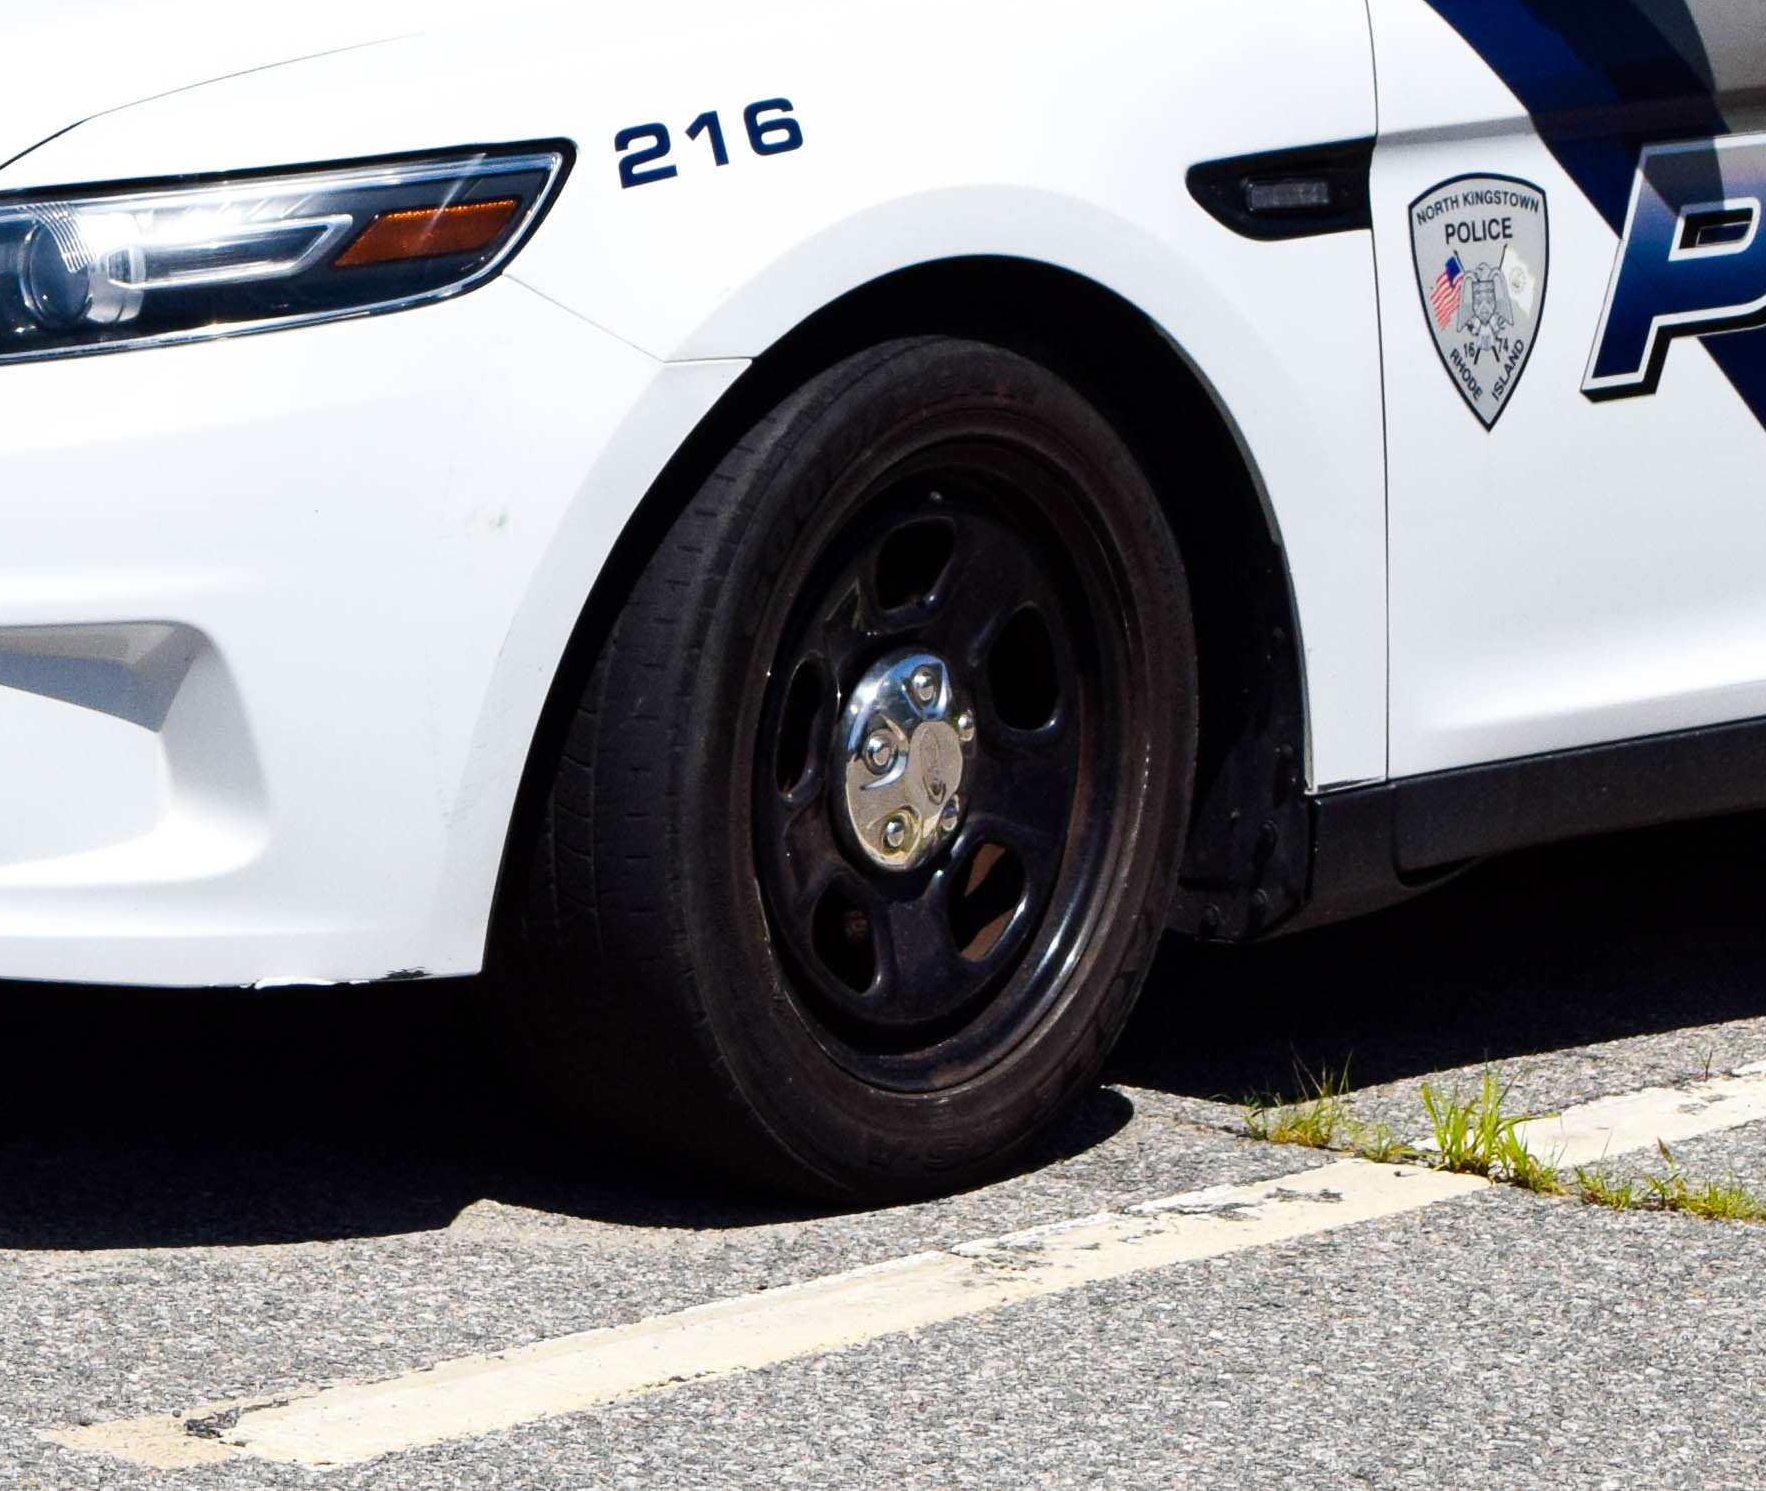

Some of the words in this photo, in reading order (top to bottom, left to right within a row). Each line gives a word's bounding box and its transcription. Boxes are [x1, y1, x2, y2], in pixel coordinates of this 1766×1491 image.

[614, 97, 803, 189] 216
[1417, 194, 1460, 225] NORTH
[1463, 190, 1539, 213] KINGSTOWN
[1445, 217, 1513, 244] POLICE
[1450, 348, 1483, 401] RHODE
[1491, 339, 1524, 401] ISLAND
